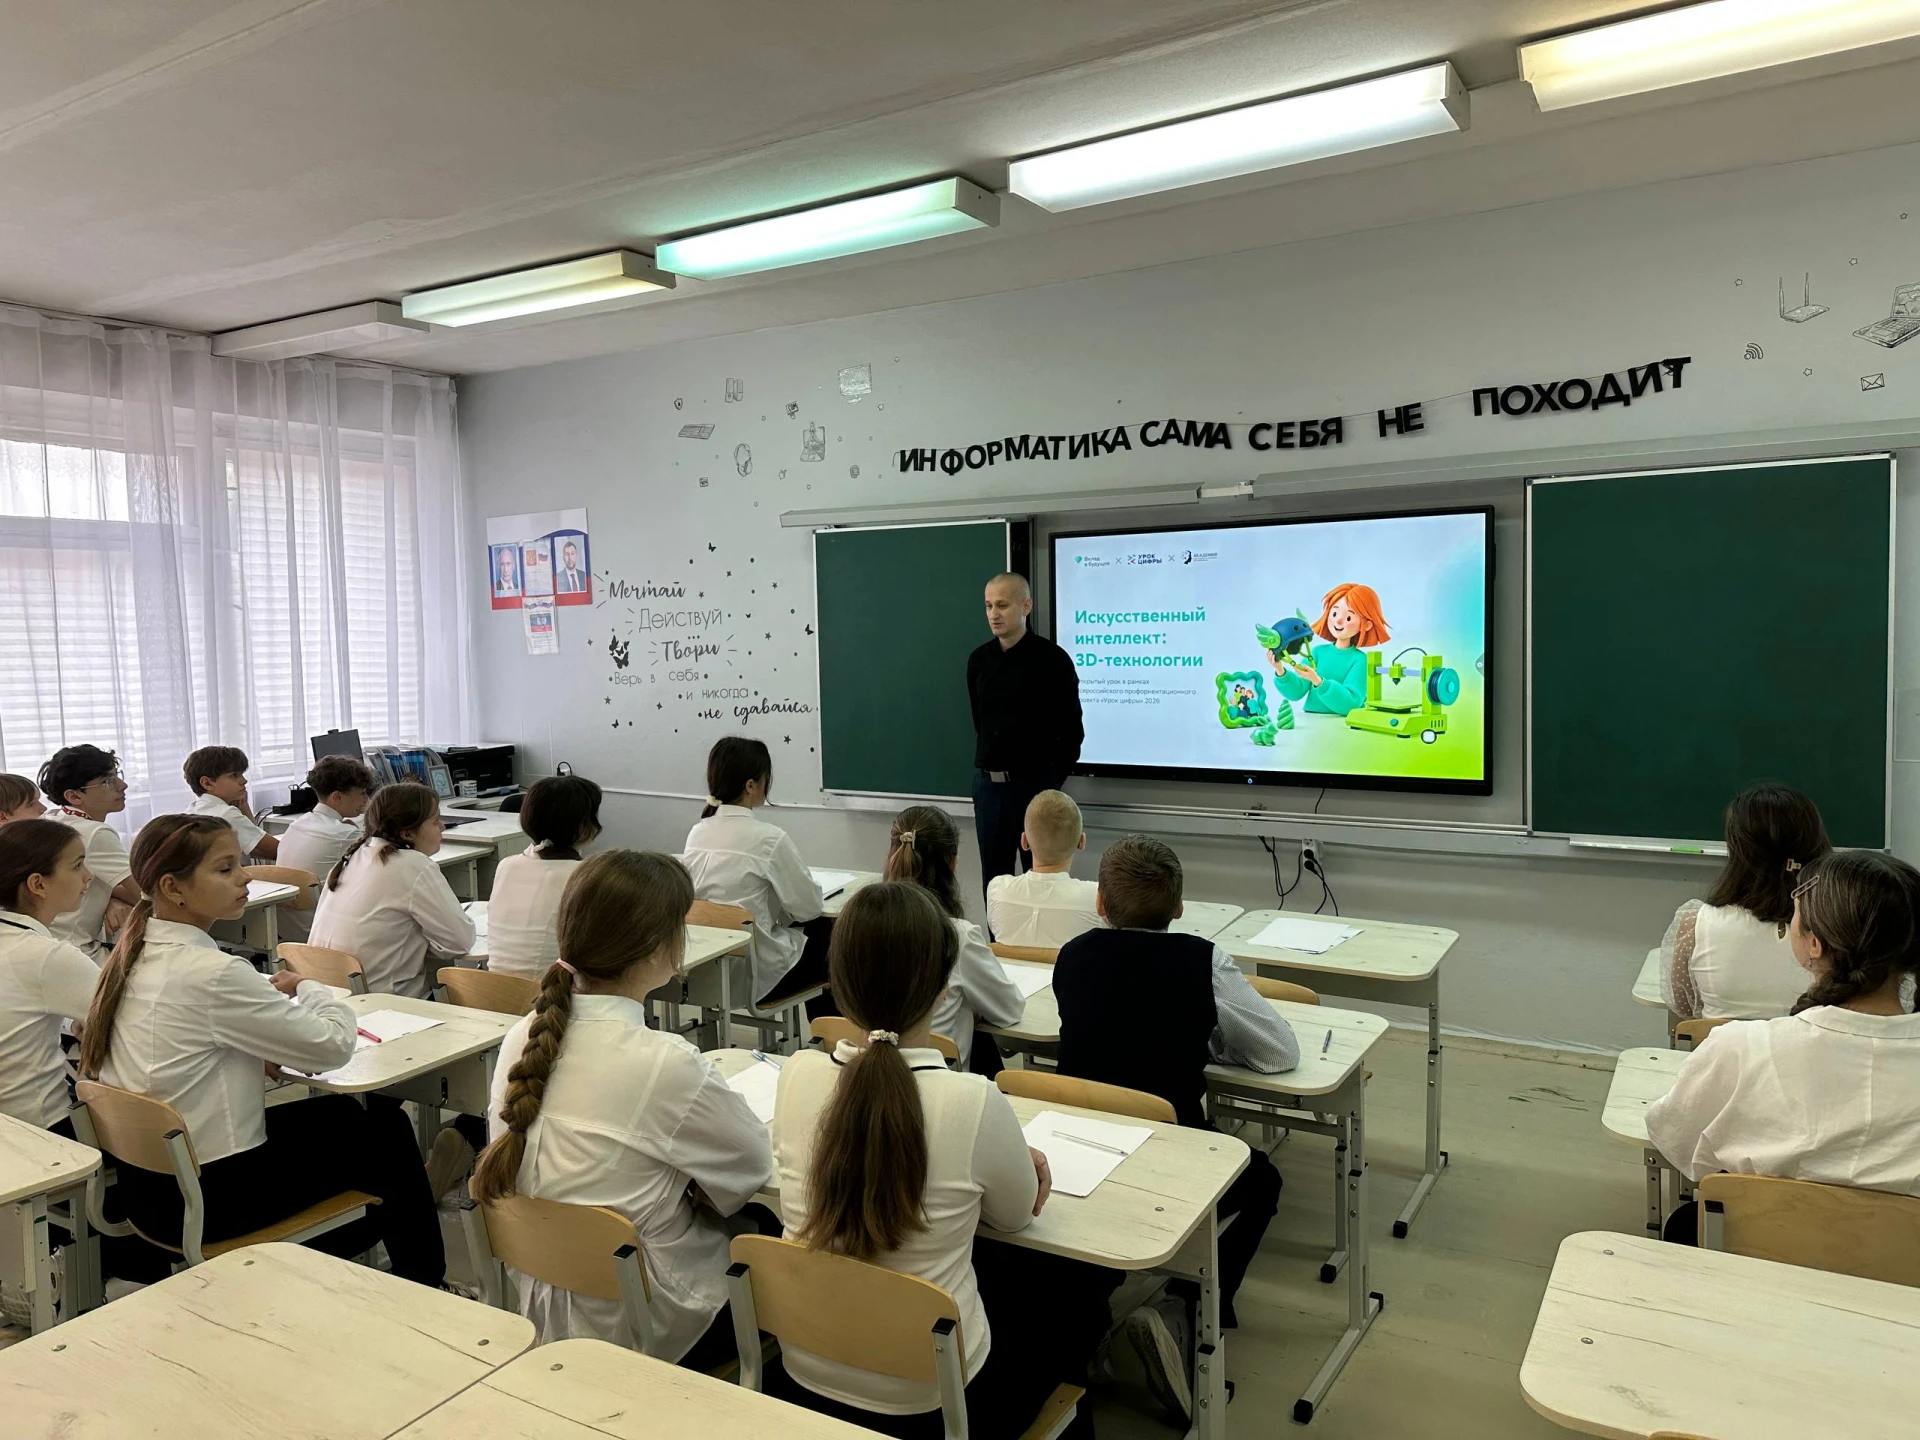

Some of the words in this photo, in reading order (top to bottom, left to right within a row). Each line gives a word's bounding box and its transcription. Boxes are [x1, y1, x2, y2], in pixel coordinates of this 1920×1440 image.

[900, 426, 1132, 475] ИНФОРМАТИКА
[1140, 419, 1232, 449] САМА
[1248, 417, 1343, 451] СЕБЯ
[1377, 402, 1425, 437] НЕ
[1472, 356, 1691, 417] ПОХОДИТ
[609, 579, 686, 600] Мечтай
[639, 608, 722, 633] Действуй
[1075, 606, 1206, 627] Искусственный
[1075, 632, 1167, 645] интеллект:
[661, 640, 720, 663] Твори
[1076, 653, 1203, 667] 3D-технологии
[614, 671, 642, 686] Верь
[650, 674, 656, 684] в
[668, 668, 699, 682] себя
[686, 691, 694, 701] и
[702, 687, 749, 700] никогда
[1079, 687, 1123, 695] сероссийского
[704, 706, 723, 720] не
[733, 698, 813, 725] сдавайся
